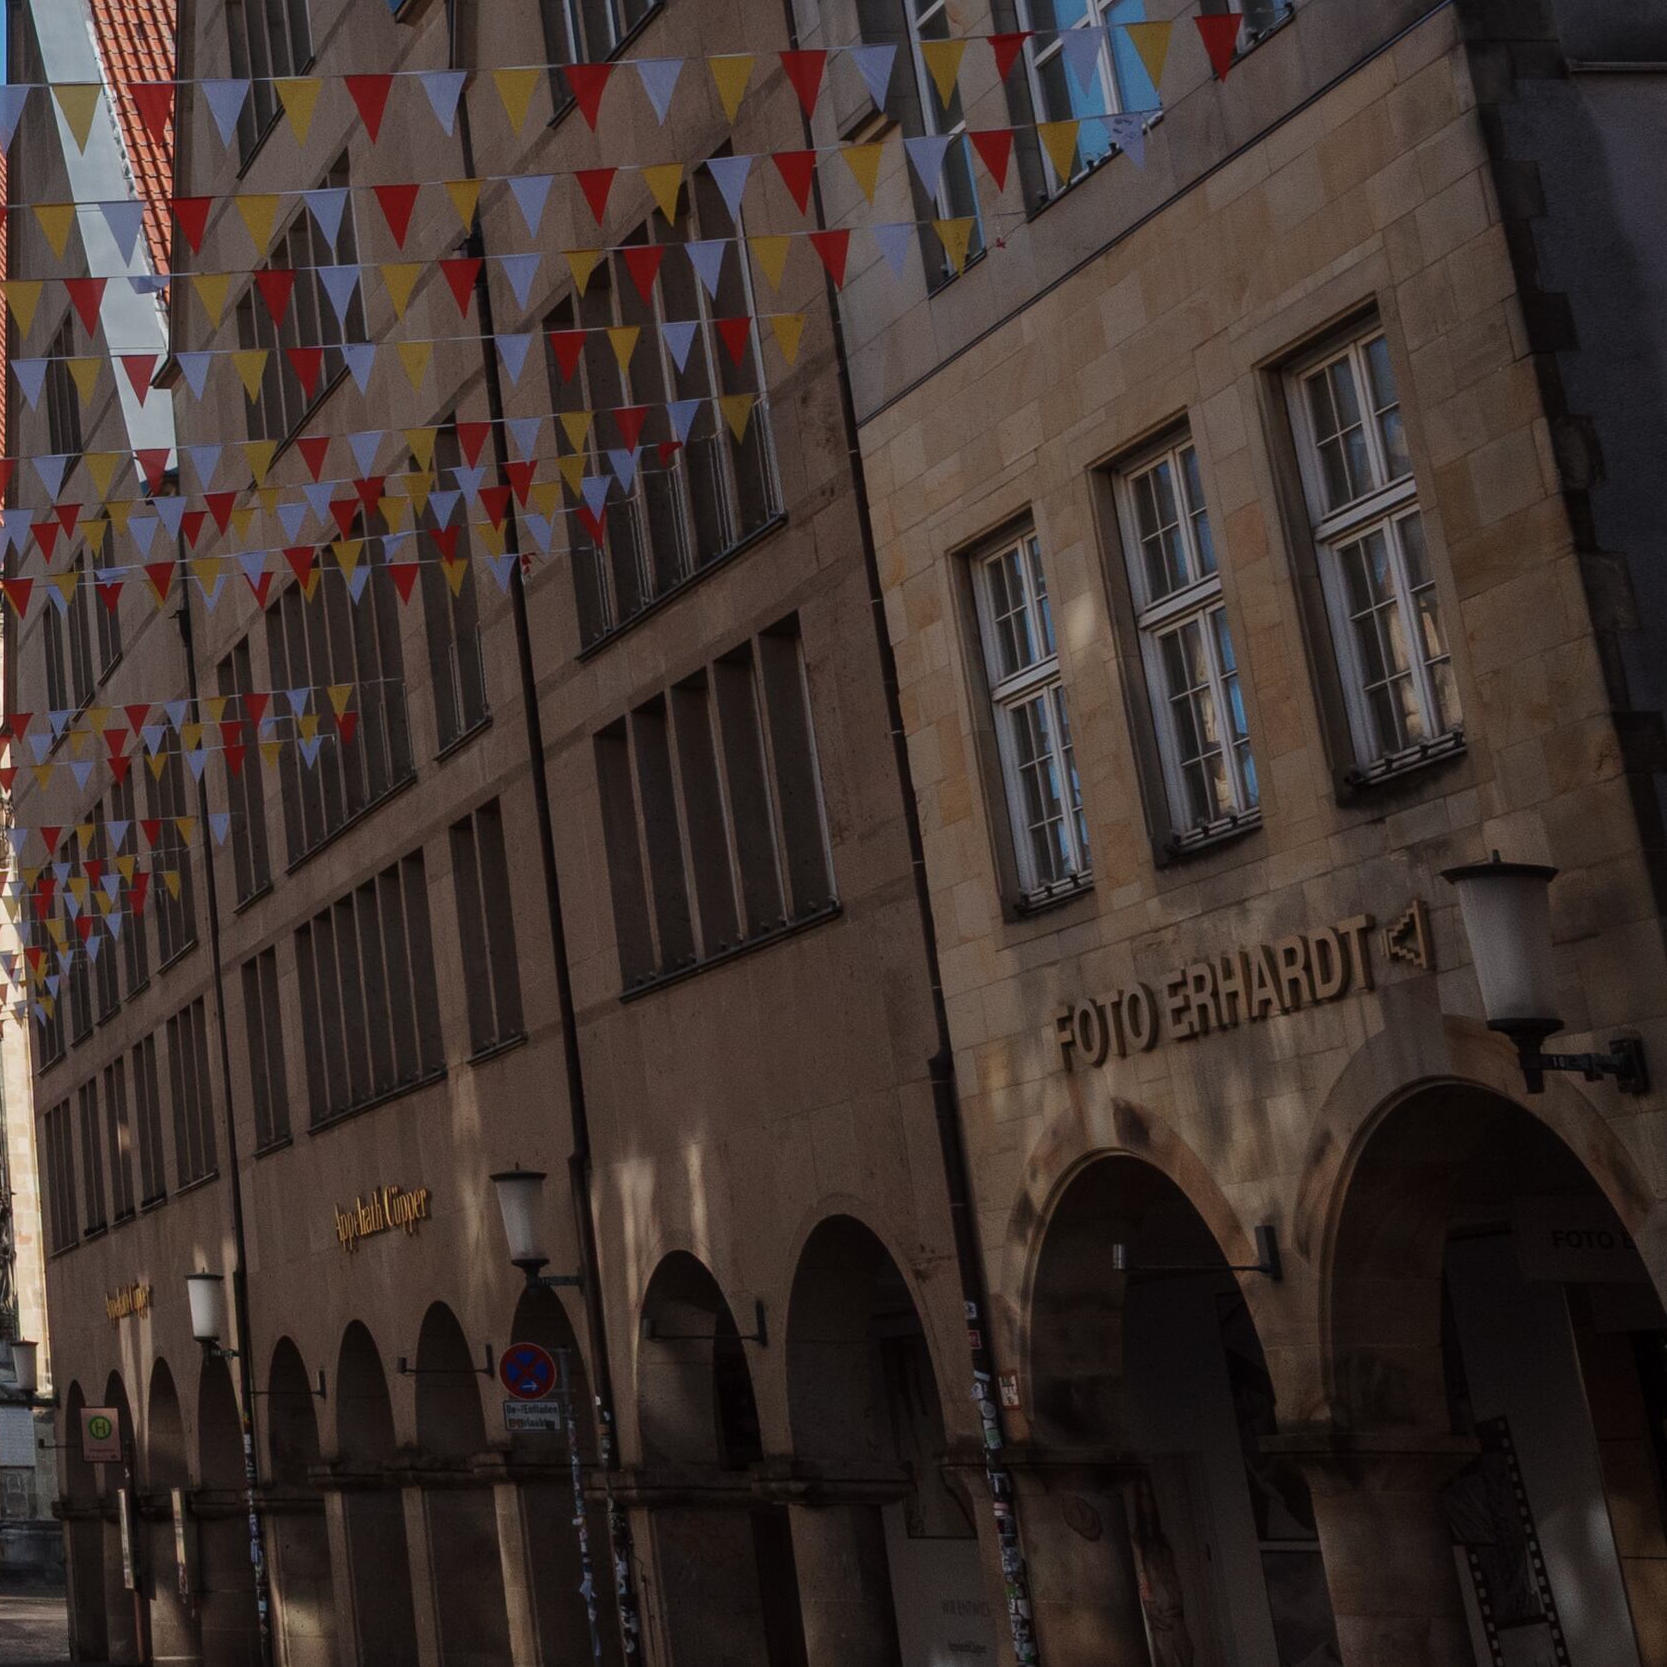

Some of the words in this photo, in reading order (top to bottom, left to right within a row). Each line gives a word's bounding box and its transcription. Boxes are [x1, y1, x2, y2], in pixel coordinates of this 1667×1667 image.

[1052, 981, 1159, 1072] FOTO
[1167, 913, 1375, 1042] ERHARDT
[1552, 1230, 1613, 1248] FOTO
